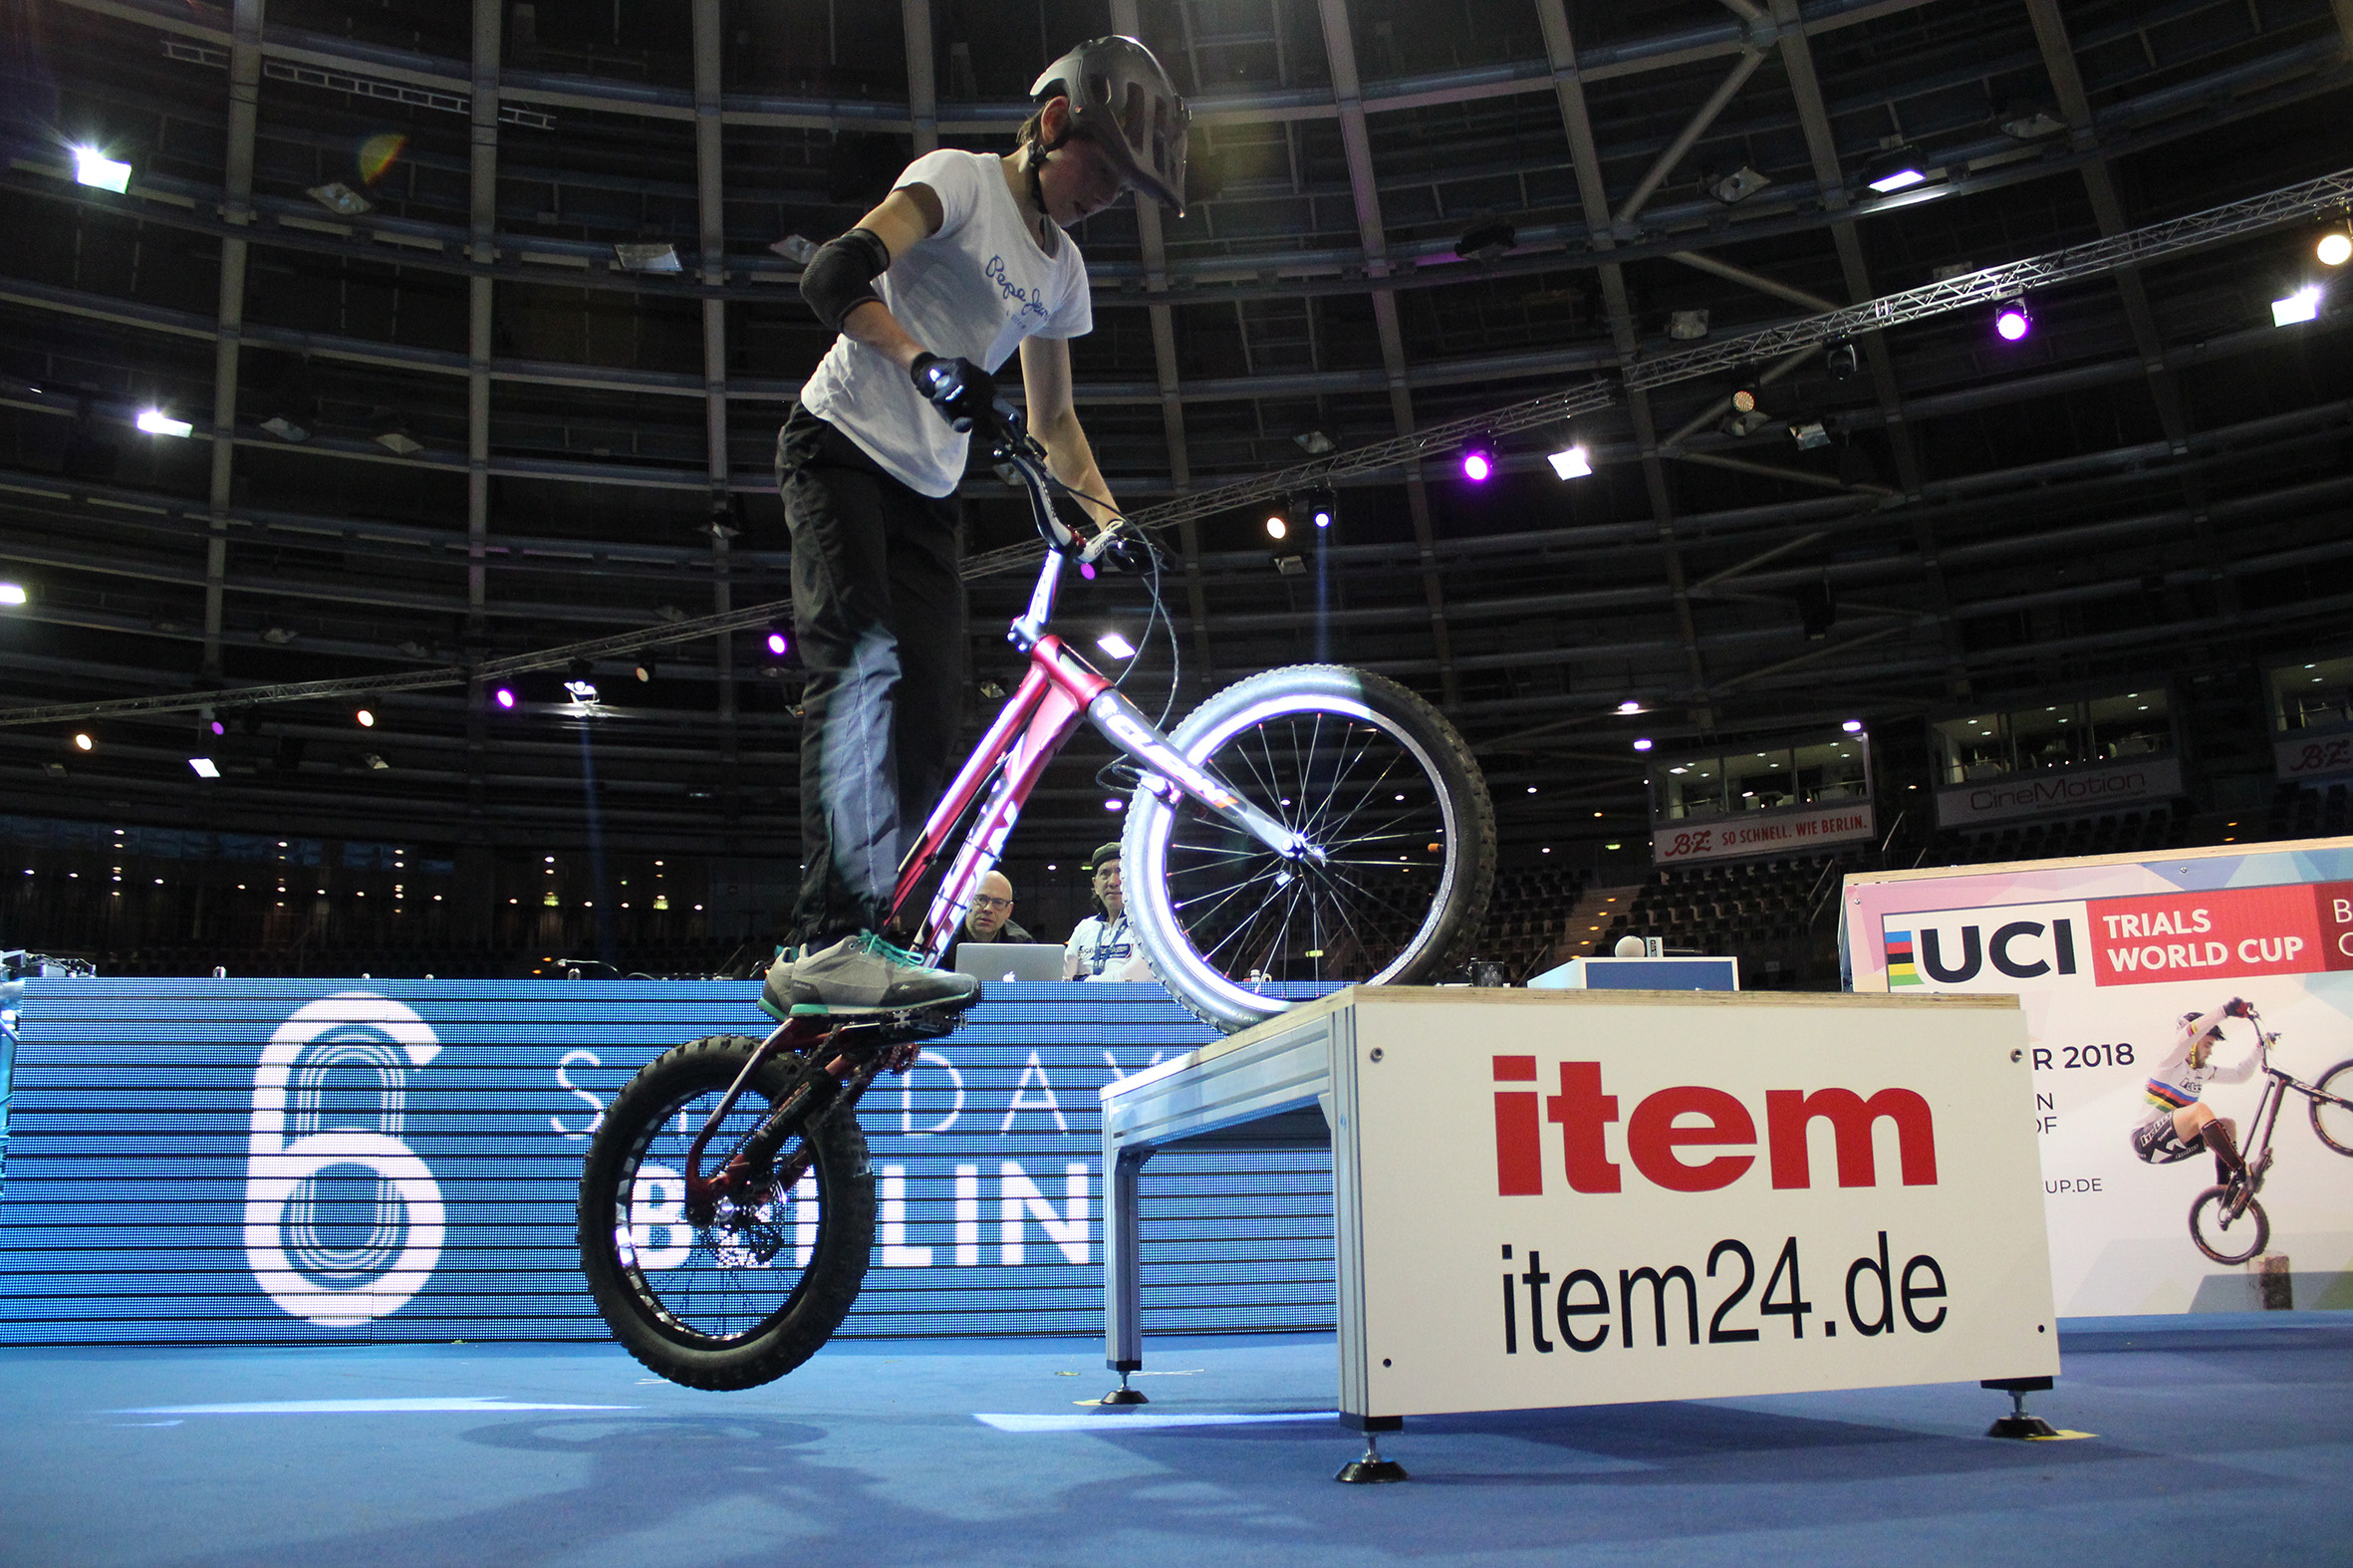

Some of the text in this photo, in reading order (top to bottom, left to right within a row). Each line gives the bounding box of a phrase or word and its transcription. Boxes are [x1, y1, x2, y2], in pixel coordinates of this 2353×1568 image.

[986, 255, 1026, 302] Pepe
[1970, 772, 2145, 811] CineMotion
[1721, 831, 1735, 846] SO
[1739, 827, 1792, 844] SCHNELL.
[1796, 821, 1817, 837] WIE
[1822, 815, 1867, 834] BERLIN.
[2103, 909, 2212, 939] TRIALS
[1921, 918, 2077, 984] UCI
[2108, 940, 2229, 972] WORLD
[2237, 936, 2304, 964] CUP
[2062, 1043, 2136, 1069] 2018
[1492, 1055, 1939, 1197] item
[243, 992, 446, 1328] 6
[1500, 1231, 1949, 1355] item24.de
